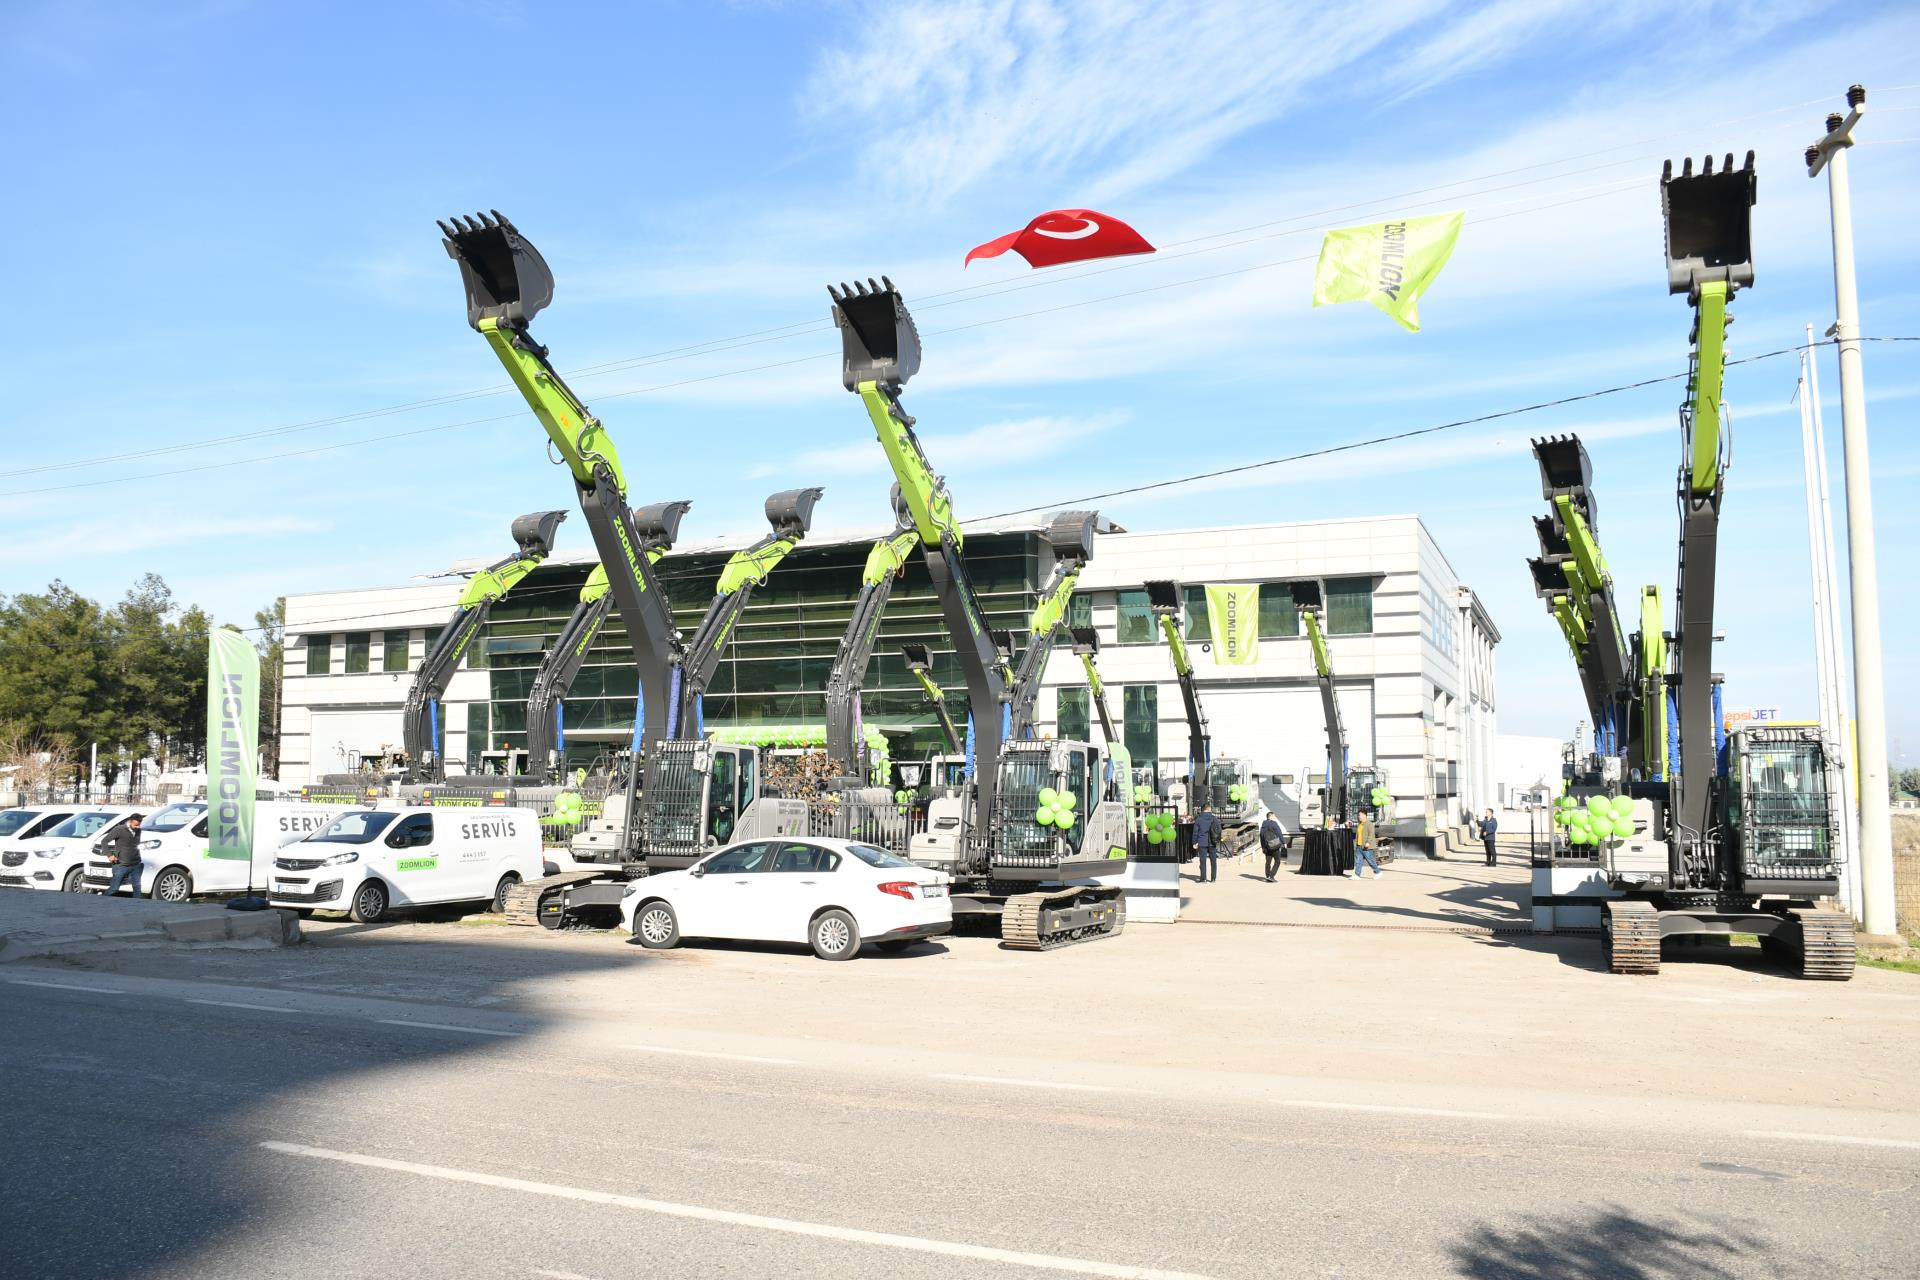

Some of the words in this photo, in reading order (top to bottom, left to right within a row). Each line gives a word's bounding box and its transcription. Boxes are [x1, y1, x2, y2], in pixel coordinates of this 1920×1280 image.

[613, 515, 647, 593] ZOOMLION
[1227, 592, 1237, 658] ZOOMLION
[461, 818, 517, 840] SERVİS
[400, 860, 435, 869] ZOOMLION
